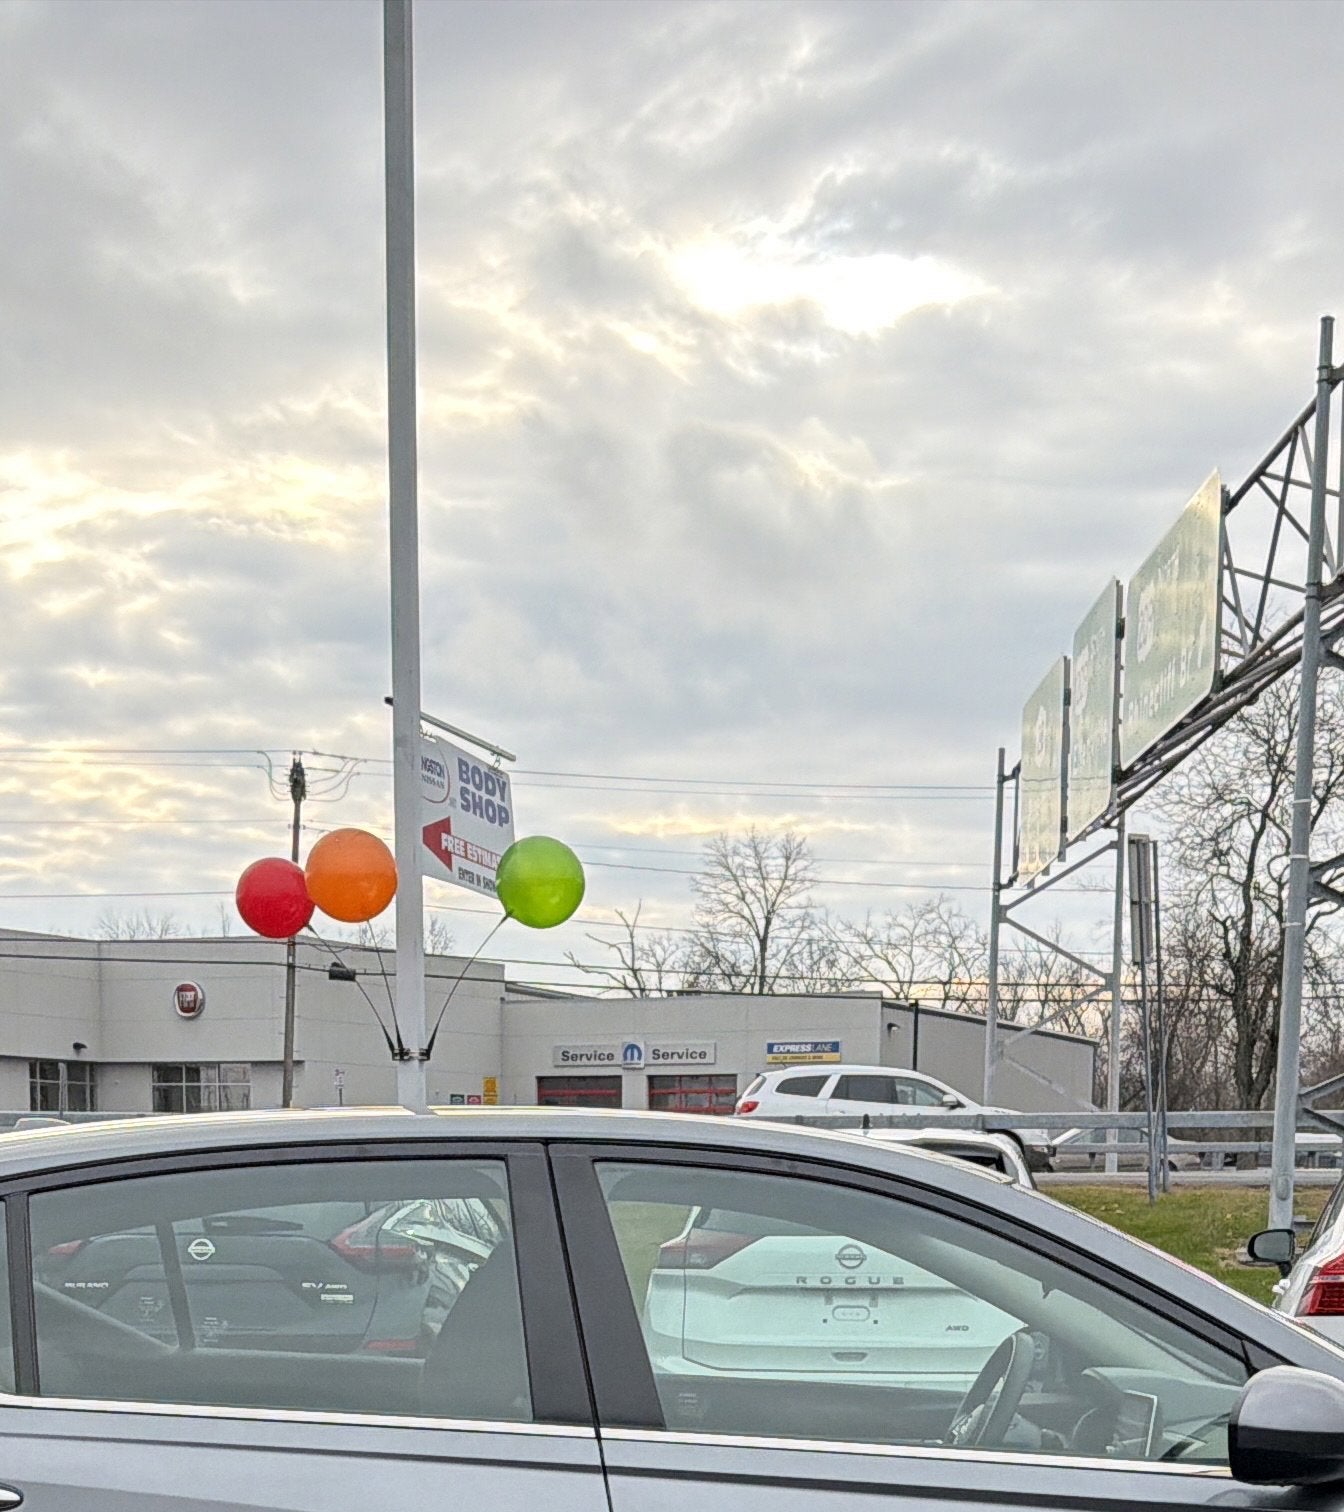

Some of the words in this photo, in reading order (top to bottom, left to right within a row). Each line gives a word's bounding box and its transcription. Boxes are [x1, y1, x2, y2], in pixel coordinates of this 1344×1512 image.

[421, 755, 446, 779] NGSTON
[458, 757, 506, 802] BODY
[460, 786, 509, 827] SHOP
[441, 832, 466, 856] FREE
[467, 841, 502, 872] ESTIMA
[561, 1050, 615, 1062] Service
[651, 1048, 707, 1060] Service
[795, 1275, 905, 1286] ROGUE
[945, 1324, 970, 1332] AWD
